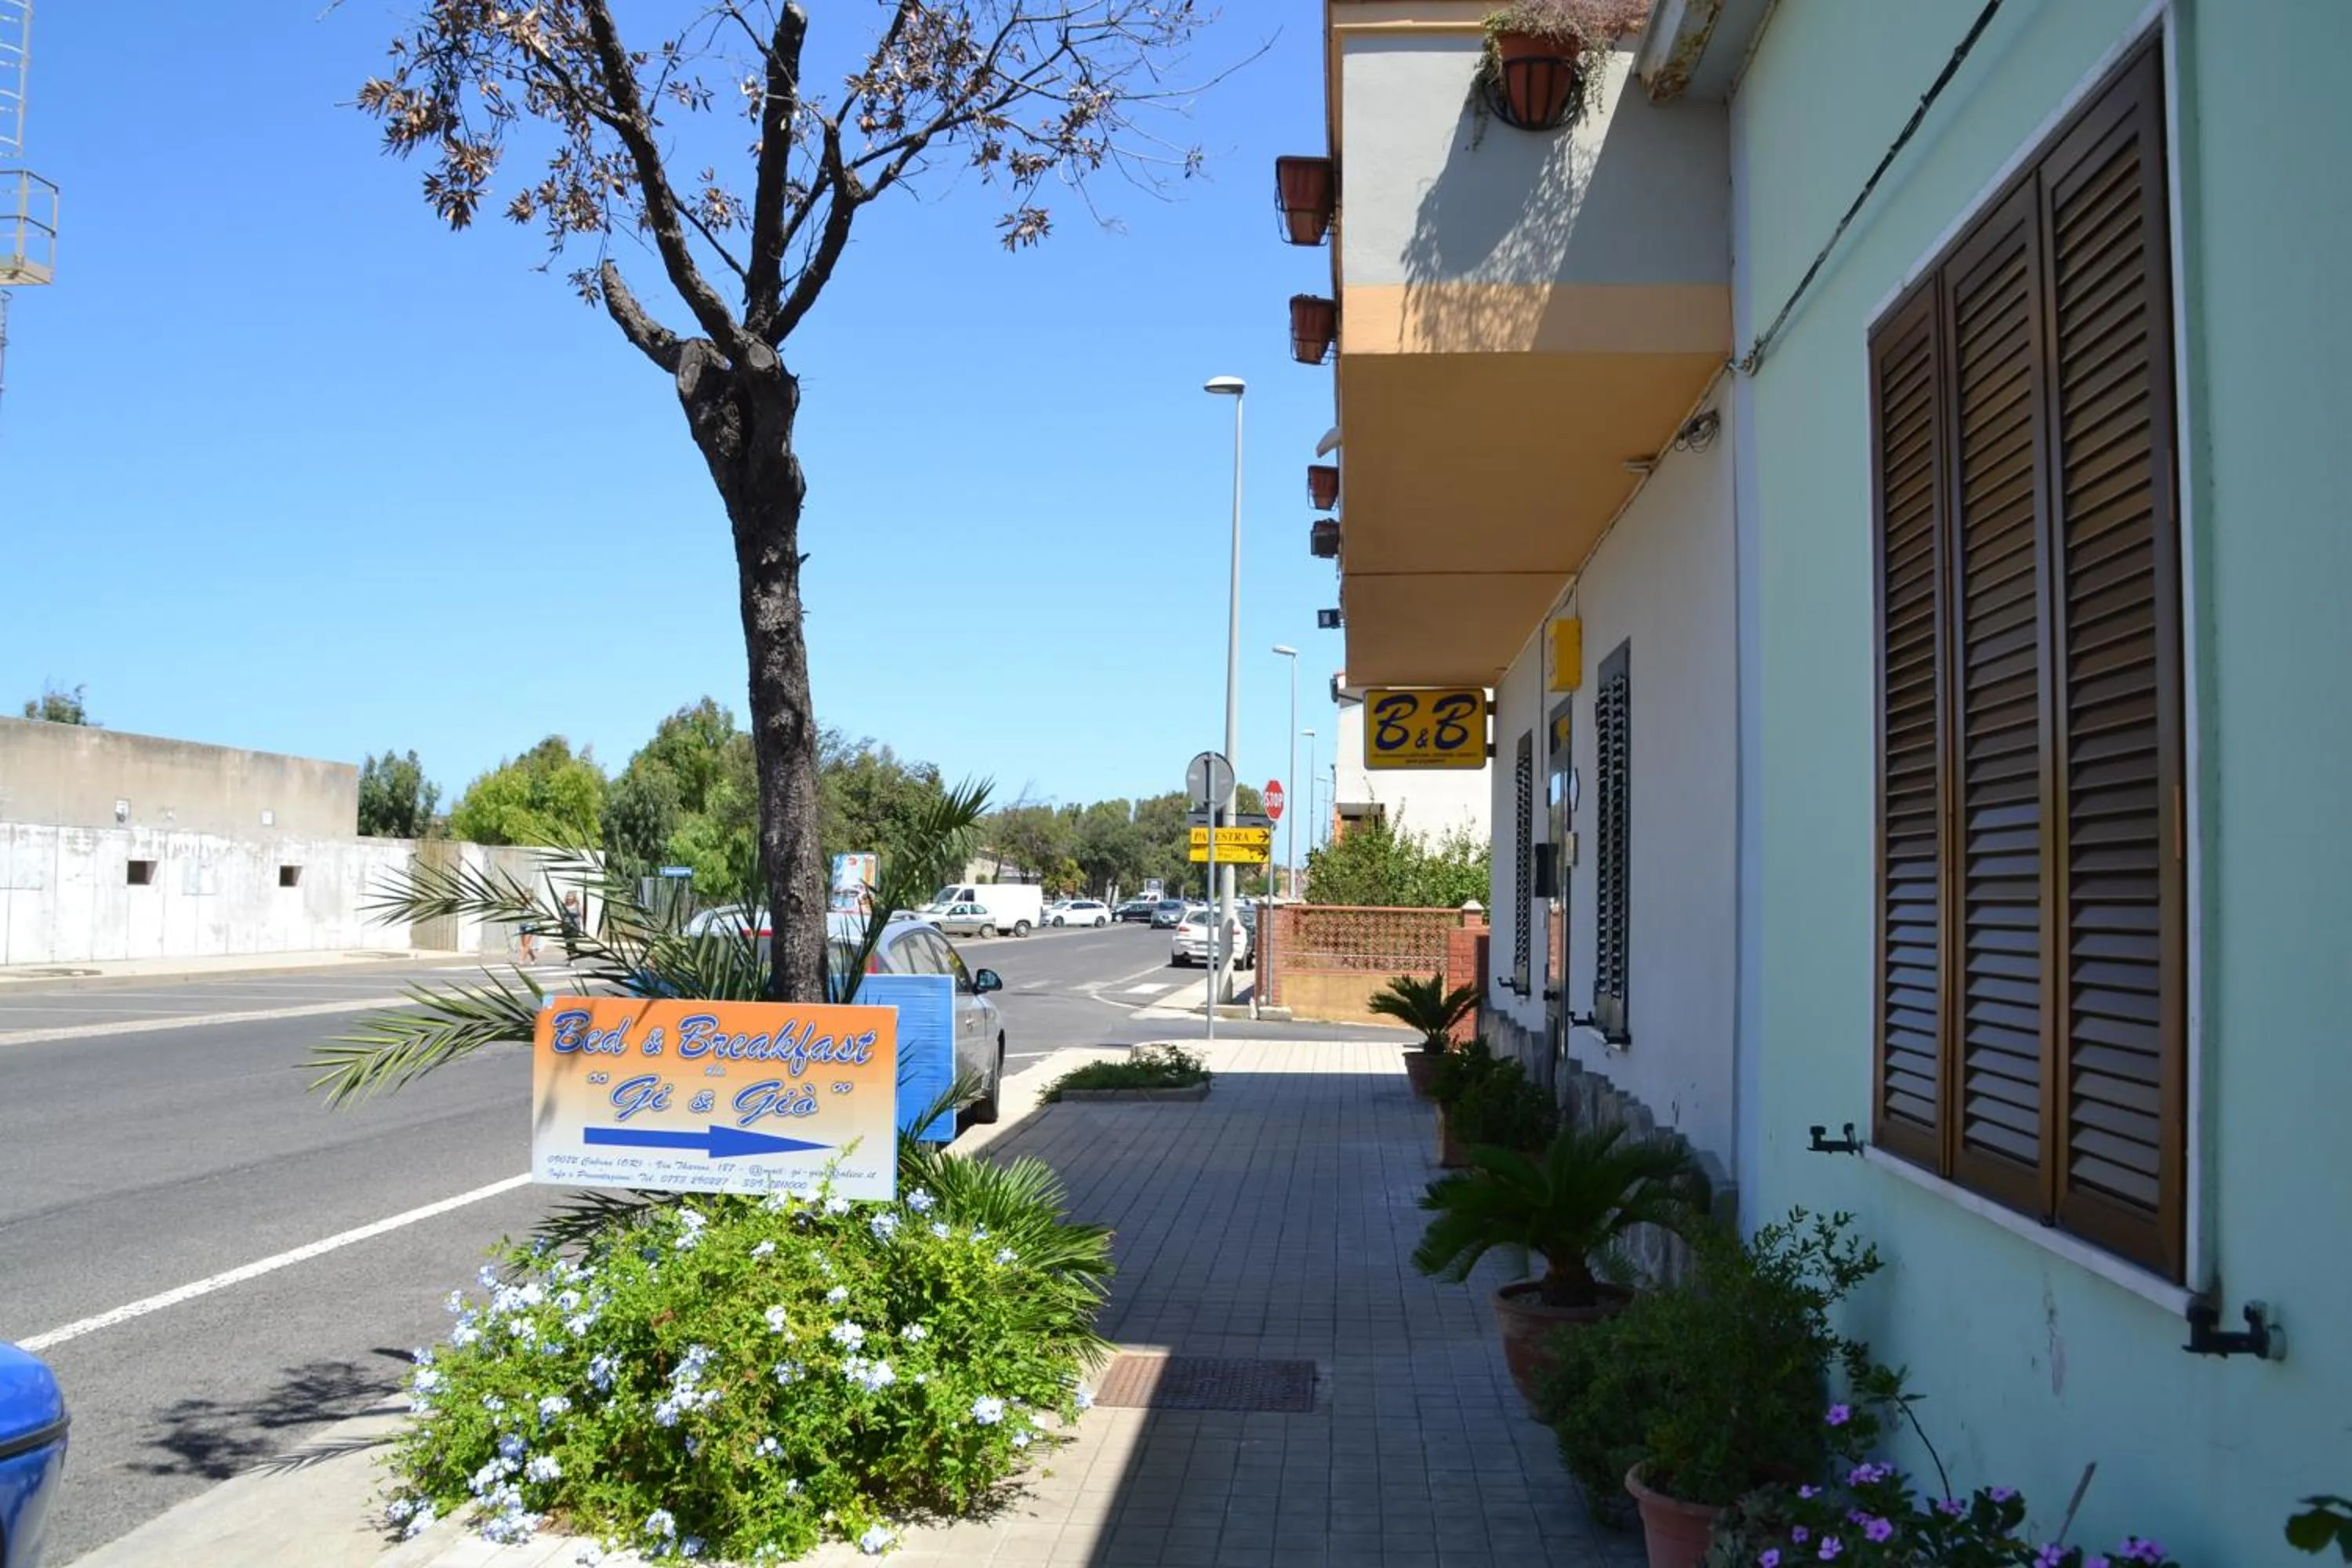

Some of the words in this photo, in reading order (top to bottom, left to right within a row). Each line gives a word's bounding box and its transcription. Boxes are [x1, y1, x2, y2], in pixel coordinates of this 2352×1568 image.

[1374, 694, 1418, 750] B
[1415, 728, 1428, 749] &
[1432, 694, 1477, 750] B
[1264, 791, 1283, 808] STOP
[1194, 831, 1250, 841] PAESTRA
[552, 1009, 632, 1054] Bed
[641, 1027, 664, 1054] &
[677, 1014, 877, 1076] Breakfast
[689, 1090, 716, 1112] &
